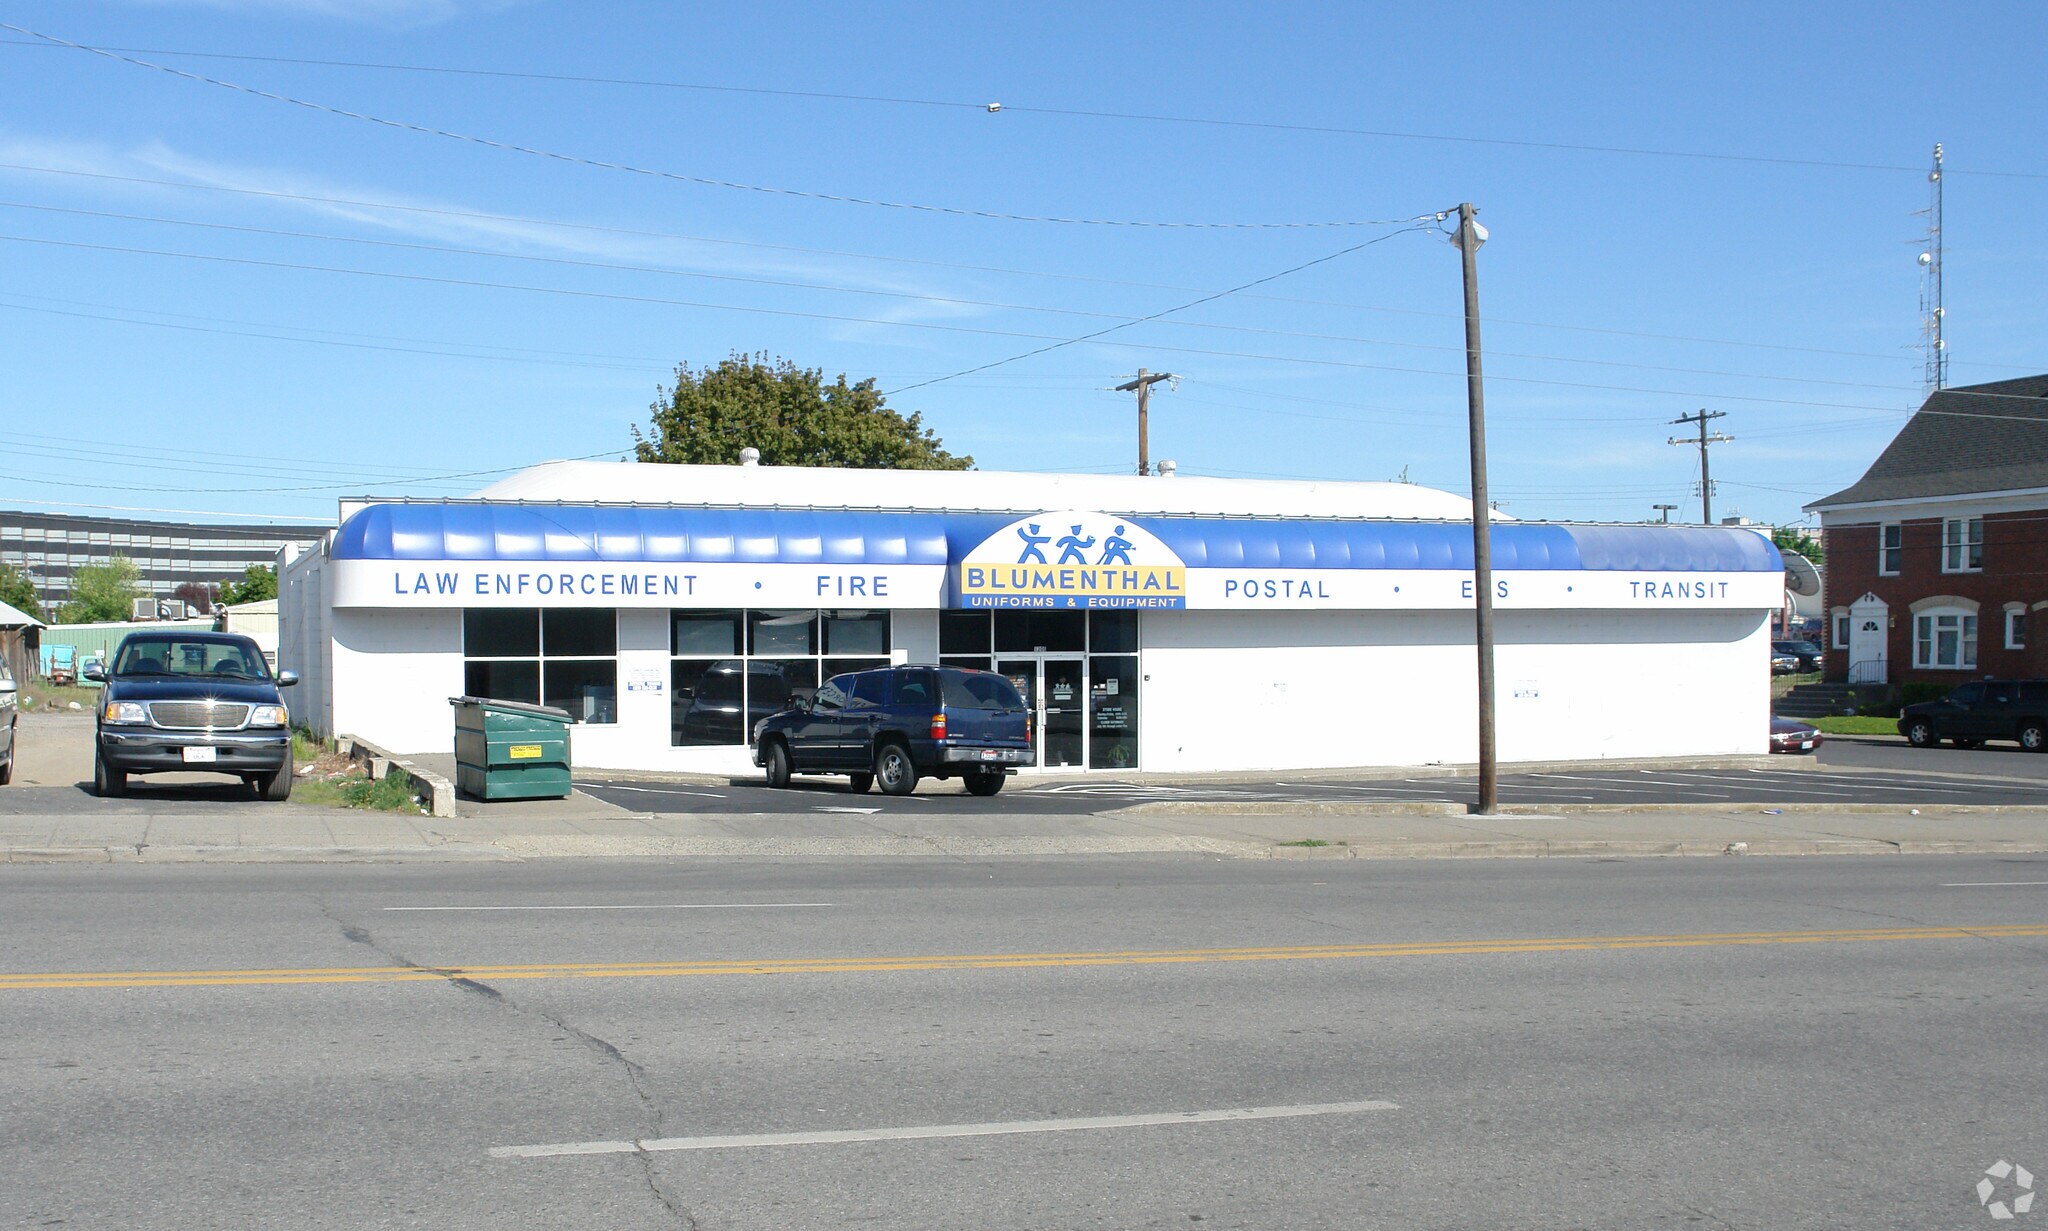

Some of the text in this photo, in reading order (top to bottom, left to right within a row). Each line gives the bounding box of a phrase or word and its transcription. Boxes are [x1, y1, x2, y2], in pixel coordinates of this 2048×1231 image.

[394, 572, 888, 597] LAW ENFORCEMENT FIRE
[967, 567, 1180, 591] BLUMENTHAL
[1225, 579, 1729, 599] POSTAL ES TRANSIT
[971, 596, 1178, 608] UNIFORMS & EQUIPMENT
